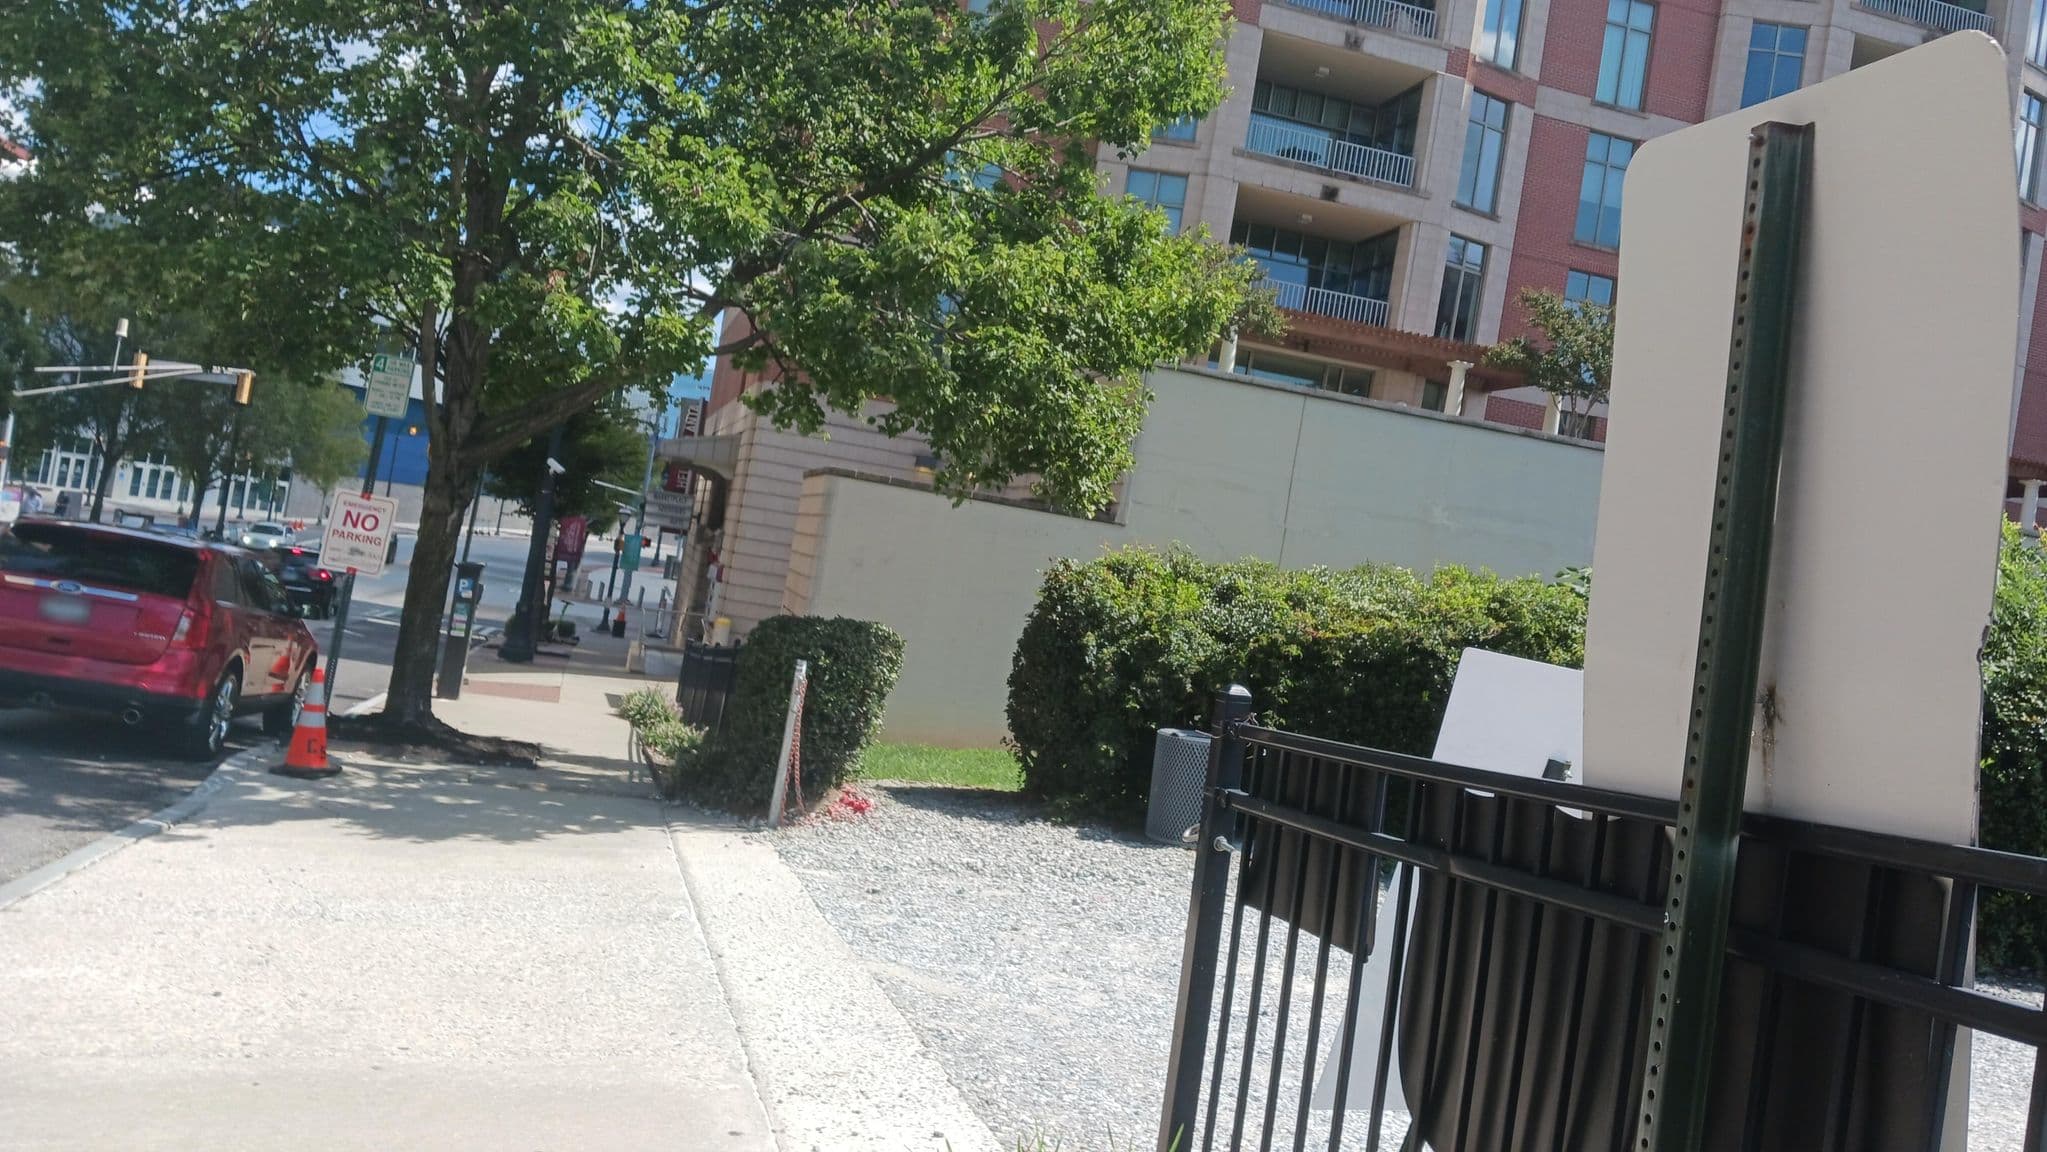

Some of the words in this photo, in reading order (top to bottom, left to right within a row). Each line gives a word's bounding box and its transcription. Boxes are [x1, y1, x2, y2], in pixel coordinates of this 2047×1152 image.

[375, 357, 385, 370] 4
[342, 510, 380, 532] NO
[331, 528, 383, 546] PARKING
